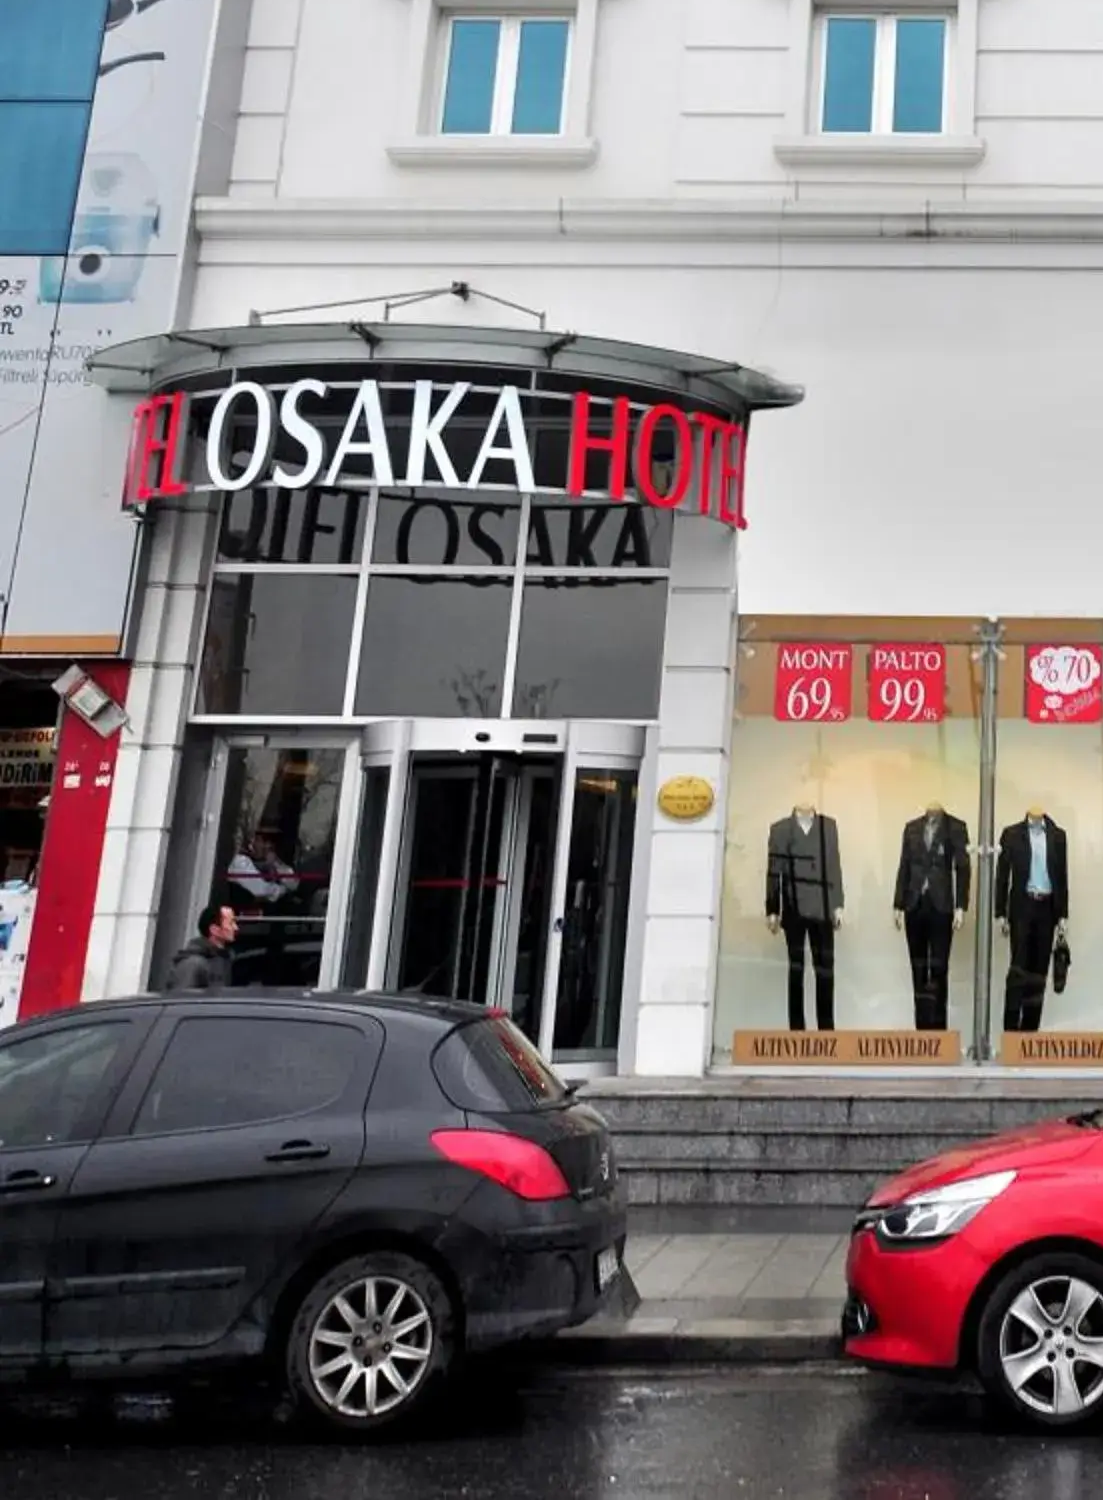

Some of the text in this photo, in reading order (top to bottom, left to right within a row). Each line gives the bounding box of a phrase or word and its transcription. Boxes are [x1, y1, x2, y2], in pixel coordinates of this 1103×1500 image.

[206, 377, 537, 493] OSAKA
[567, 390, 748, 531] HOTEL
[780, 650, 849, 670] MONT
[874, 650, 942, 671] PALTO
[787, 676, 832, 720] 69
[880, 677, 926, 721] 99
[752, 1037, 942, 1059] ALTINYILDIZ ALTINYILDIZ
